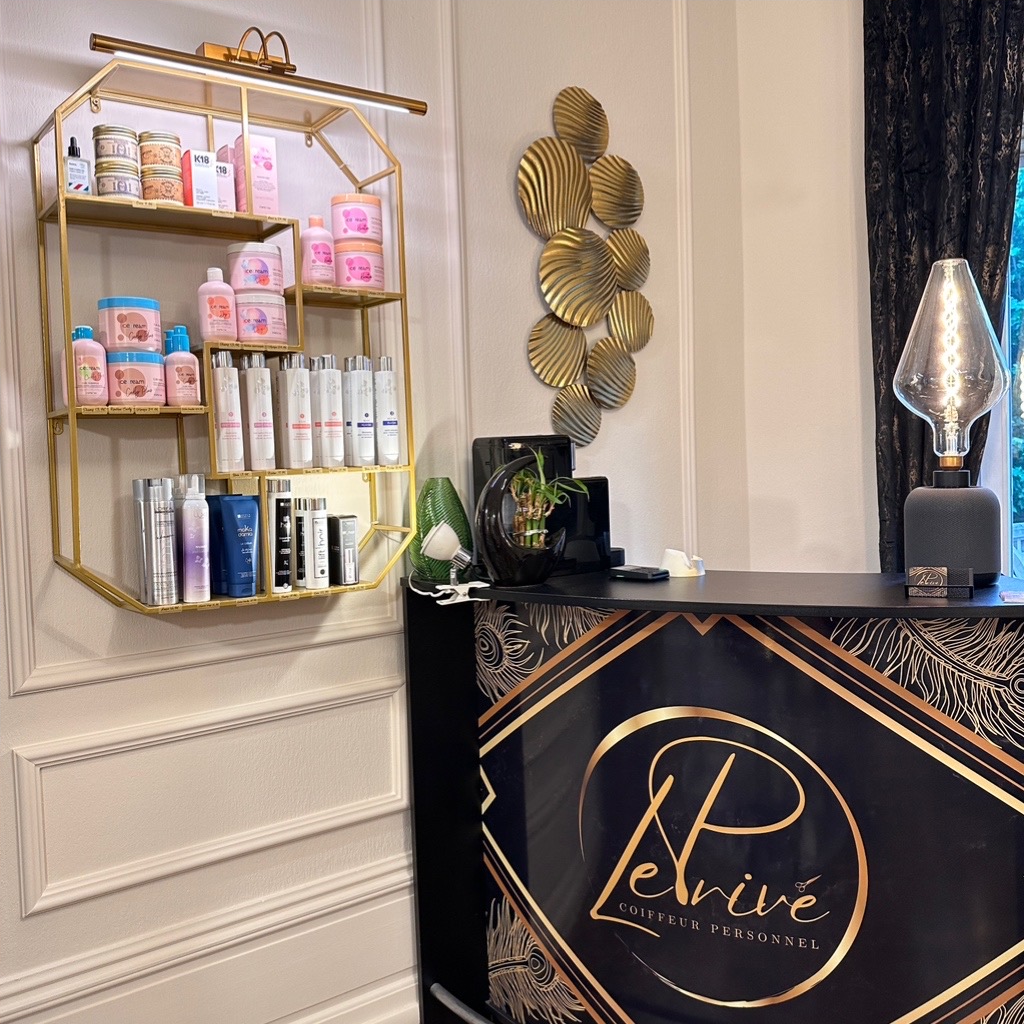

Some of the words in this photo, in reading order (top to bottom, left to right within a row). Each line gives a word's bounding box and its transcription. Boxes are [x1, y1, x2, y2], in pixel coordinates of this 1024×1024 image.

[194, 154, 210, 164] K18
[619, 902, 700, 931] COIFFEUR
[711, 924, 820, 950] PERSONNEL
